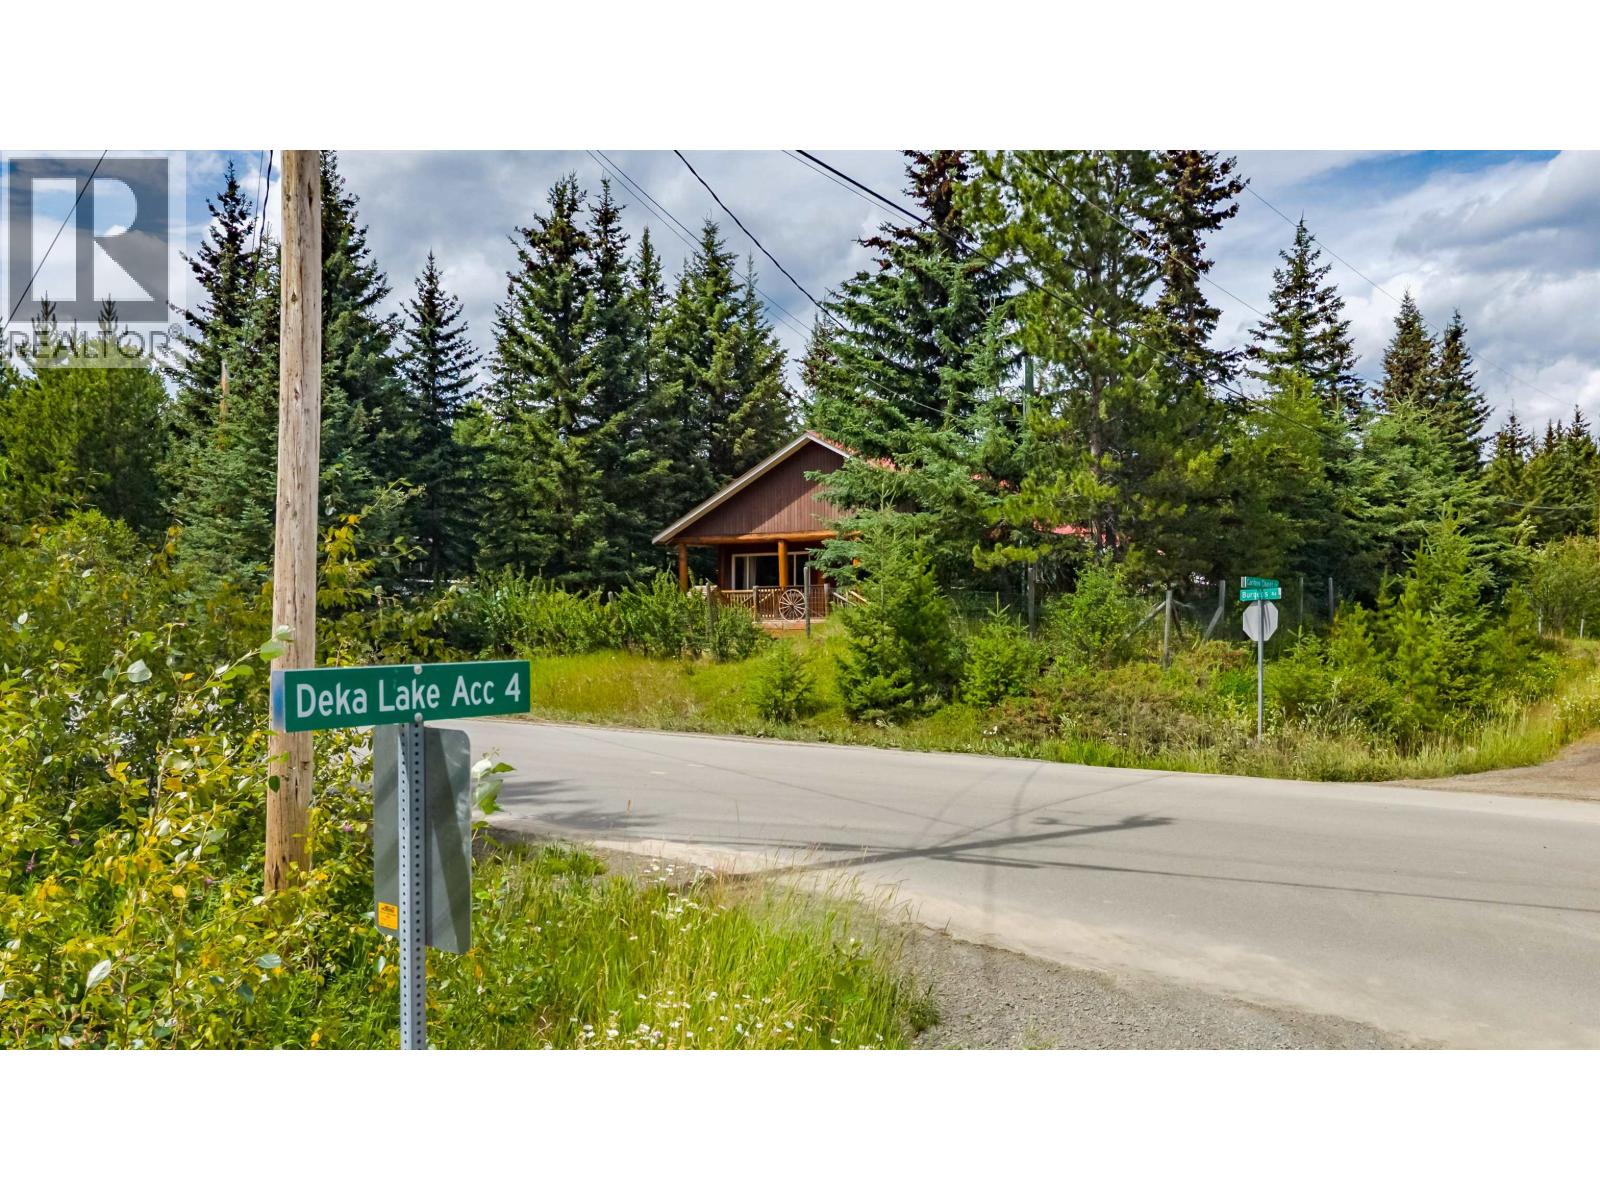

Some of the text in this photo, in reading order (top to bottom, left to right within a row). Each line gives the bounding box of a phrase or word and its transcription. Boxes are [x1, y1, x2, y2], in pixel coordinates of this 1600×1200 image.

[297, 672, 521, 718] Deka Lake Acc 4
